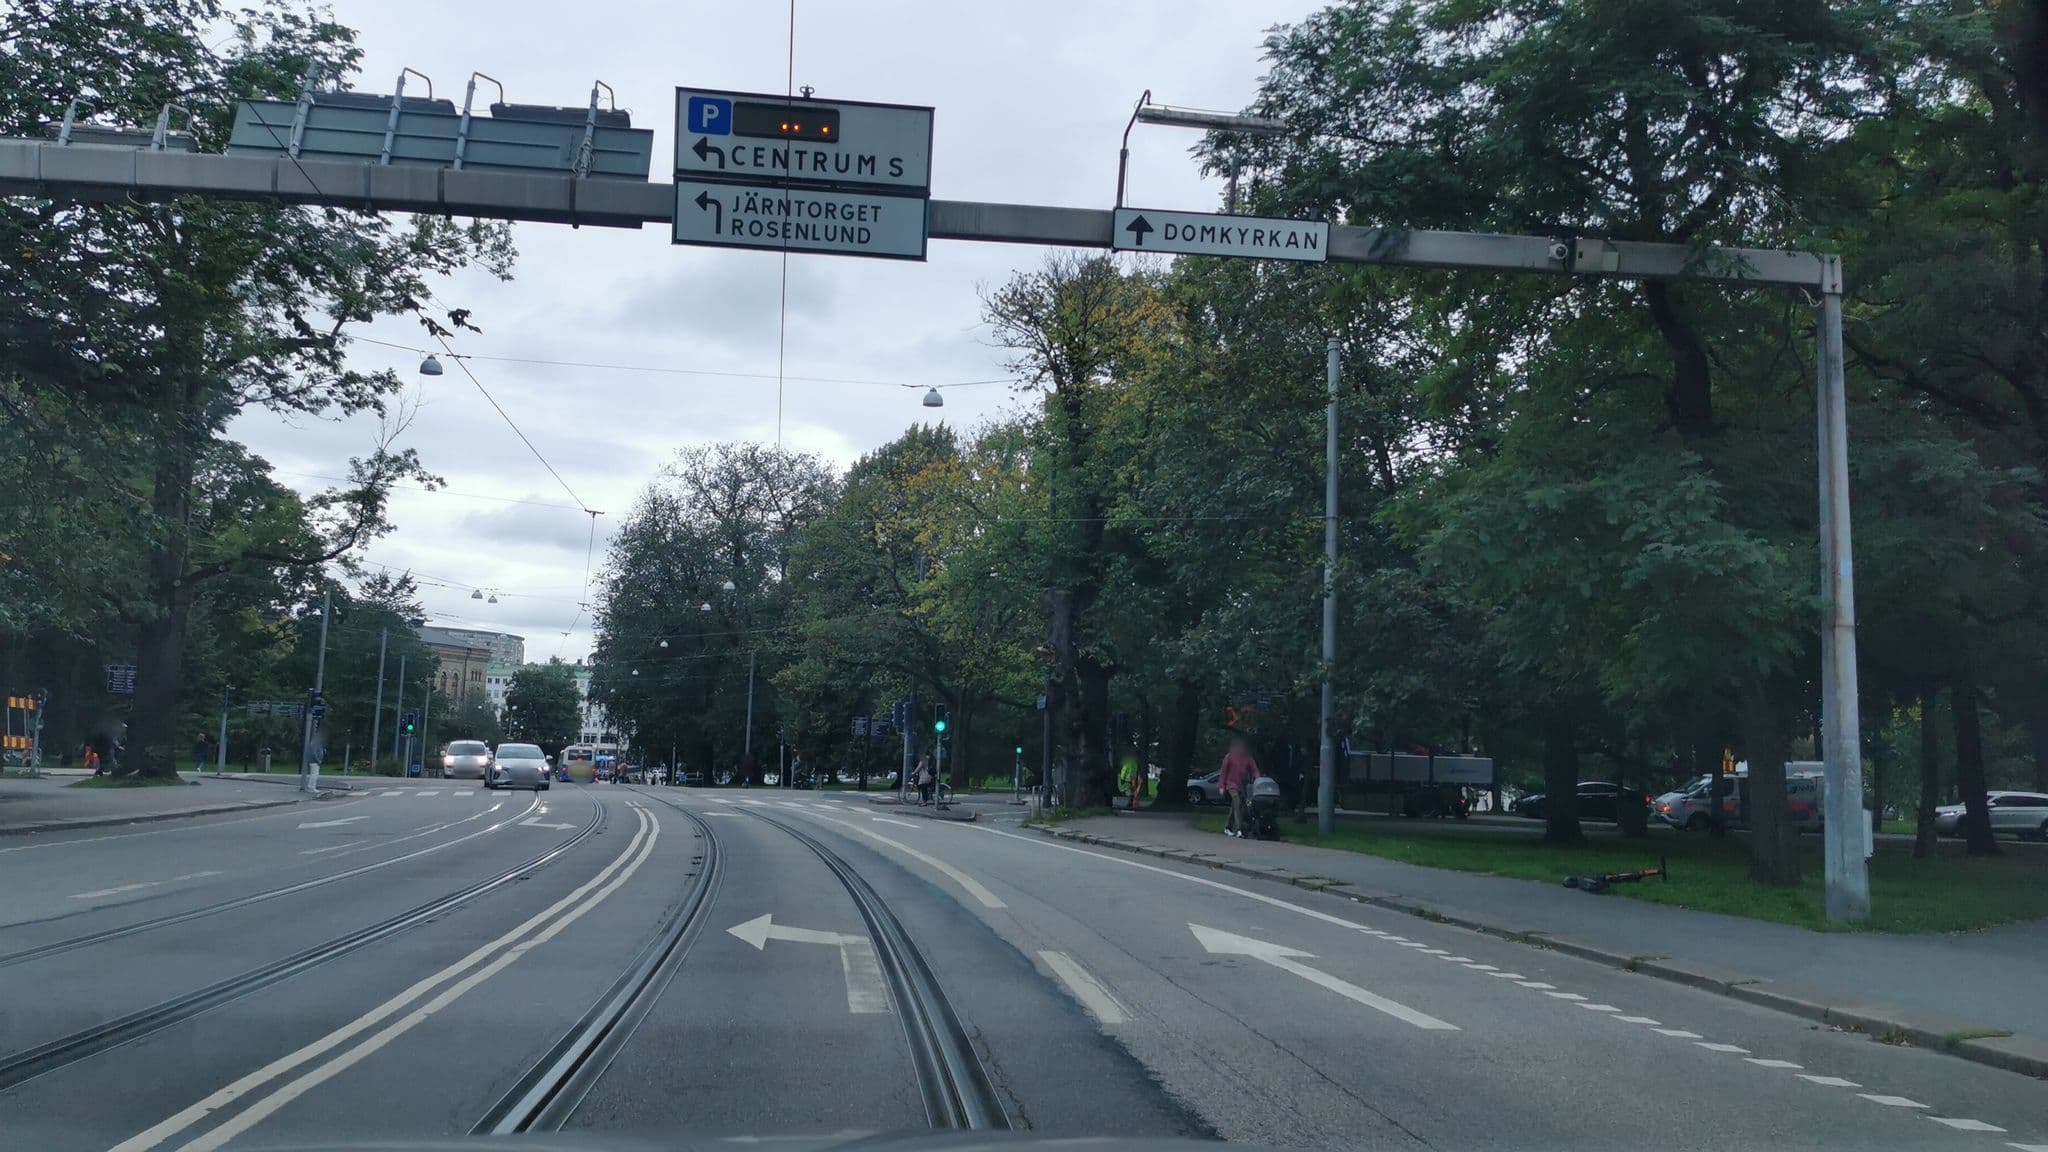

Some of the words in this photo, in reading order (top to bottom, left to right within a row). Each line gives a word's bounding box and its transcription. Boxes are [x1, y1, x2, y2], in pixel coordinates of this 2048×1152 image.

[702, 103, 719, 128] P
[732, 145, 875, 176] CENTRUM
[889, 157, 904, 177] S
[732, 191, 882, 223] JÄRNTORGET
[731, 219, 871, 244] ROSENLUND
[1165, 223, 1318, 250] DOMKYRKAN
